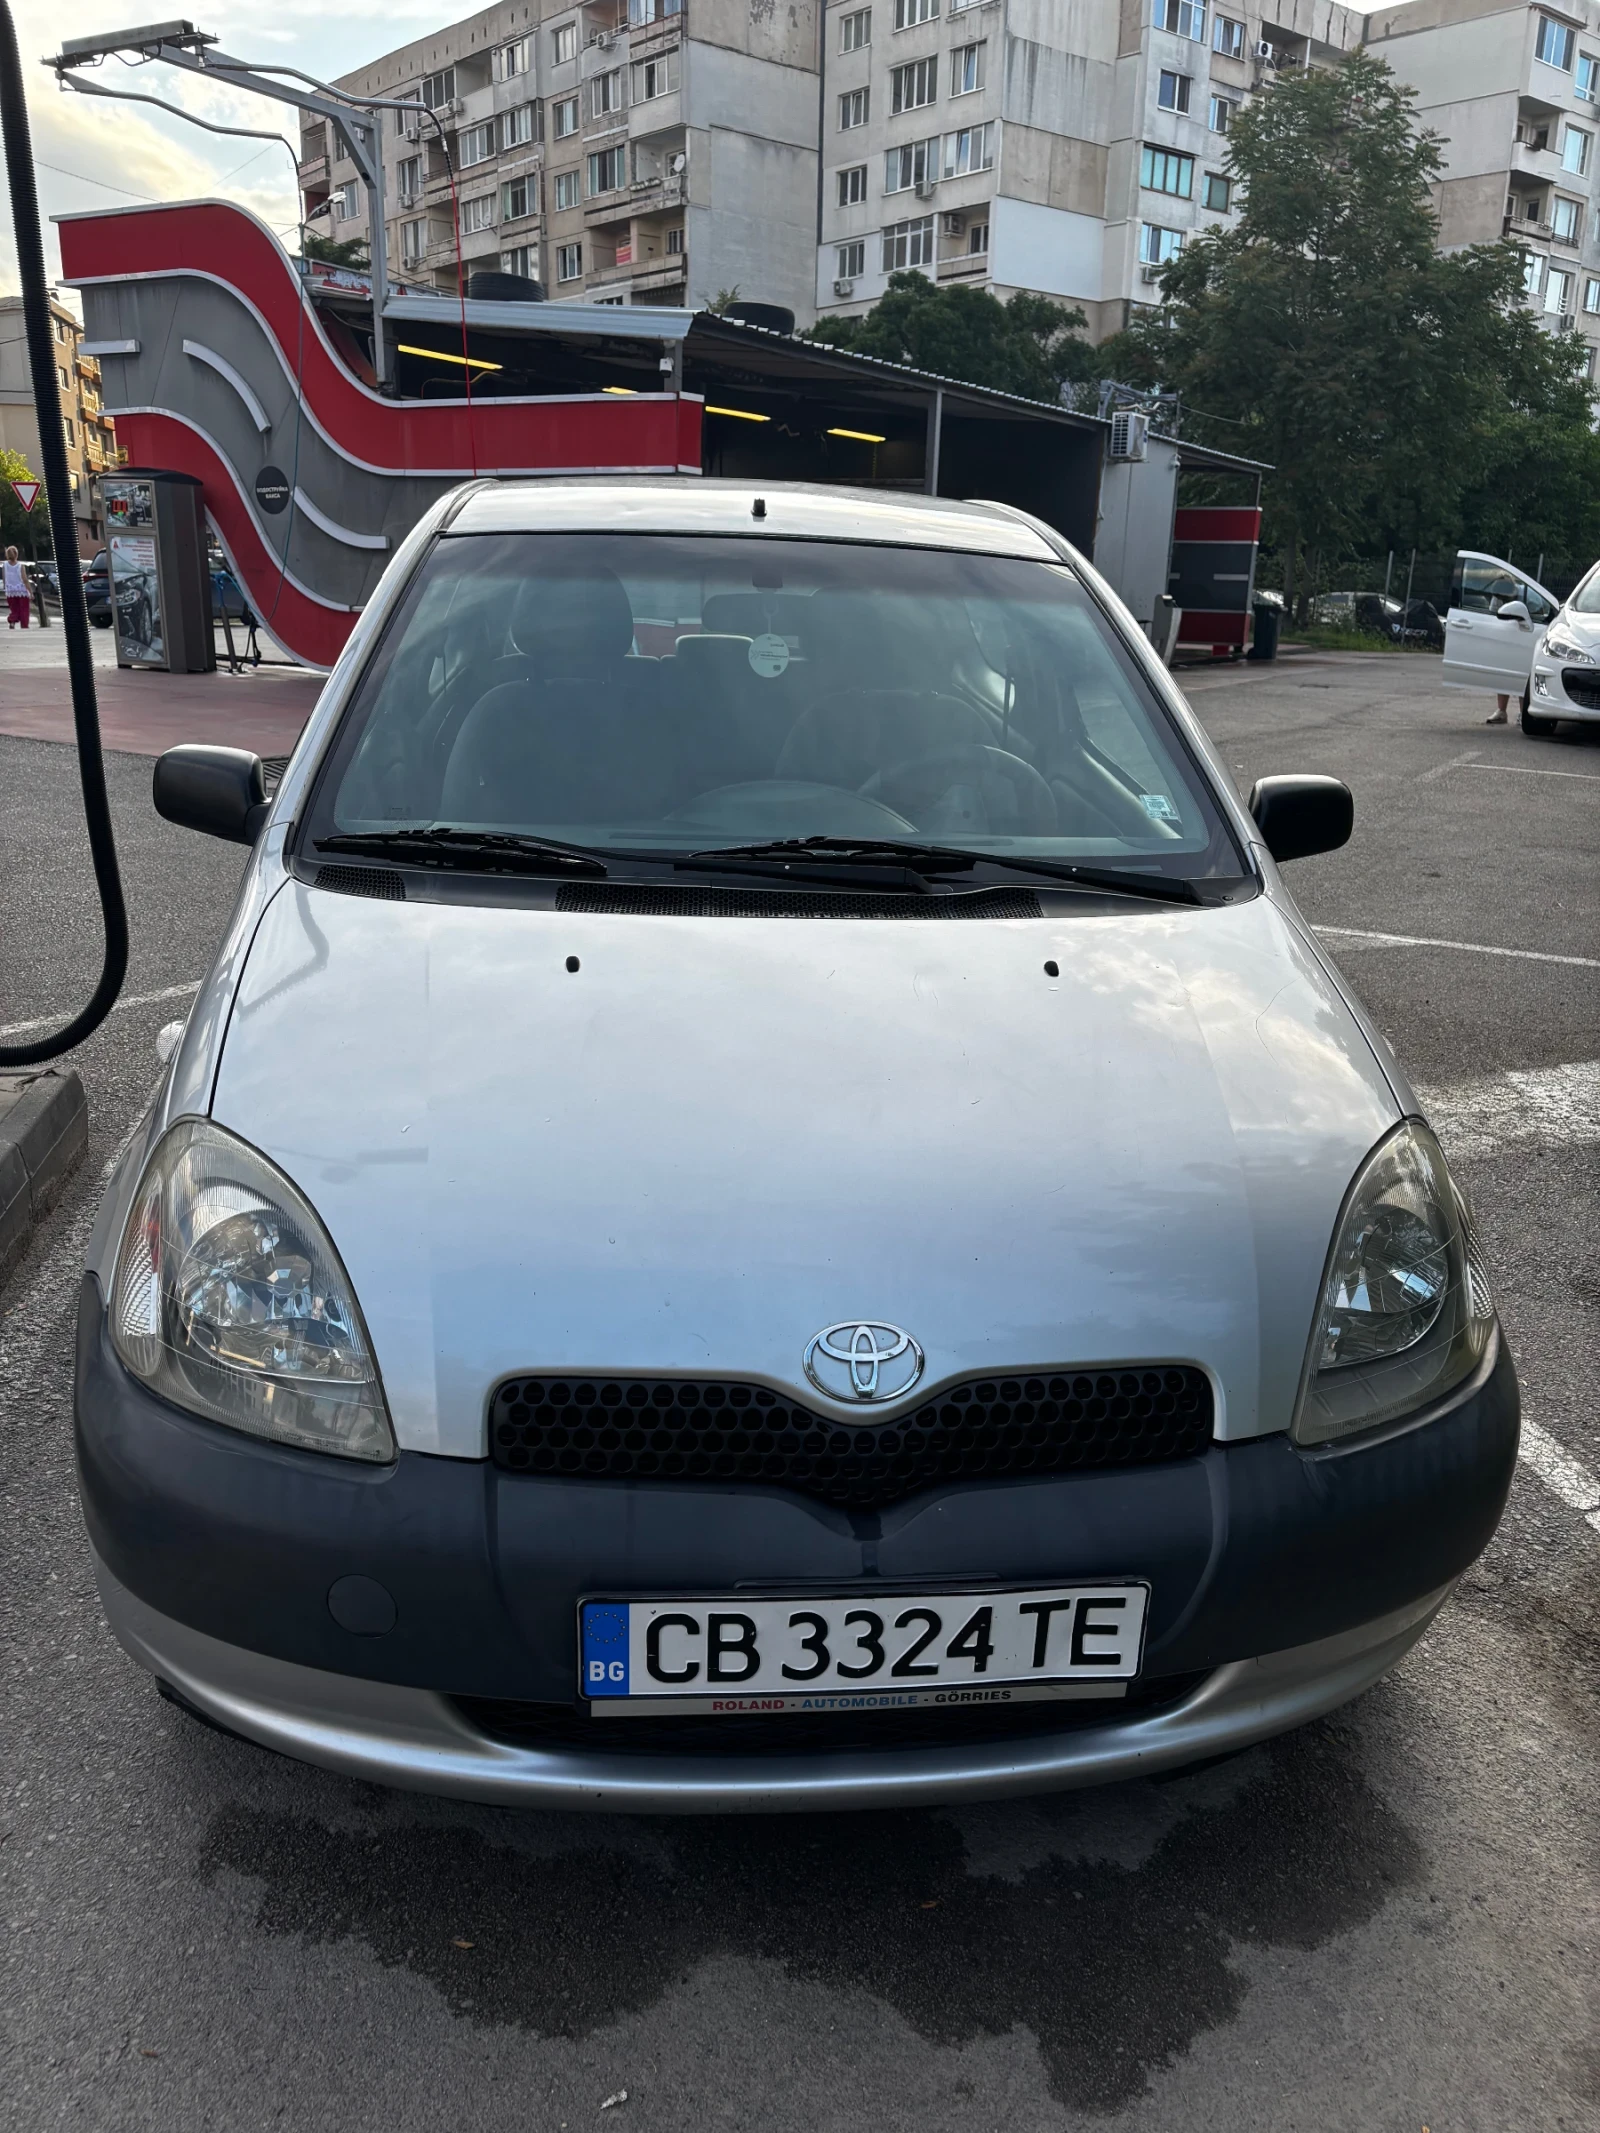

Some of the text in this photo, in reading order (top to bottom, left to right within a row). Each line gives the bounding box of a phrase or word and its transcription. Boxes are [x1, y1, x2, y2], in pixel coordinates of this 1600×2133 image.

[646, 1597, 1127, 1683] CB 3324 TE
[589, 1661, 625, 1682] BG
[712, 1700, 785, 1711] ROLAND
[801, 1695, 918, 1709] AUTOMOBILE
[934, 1690, 1012, 1703] GÖRRIES
